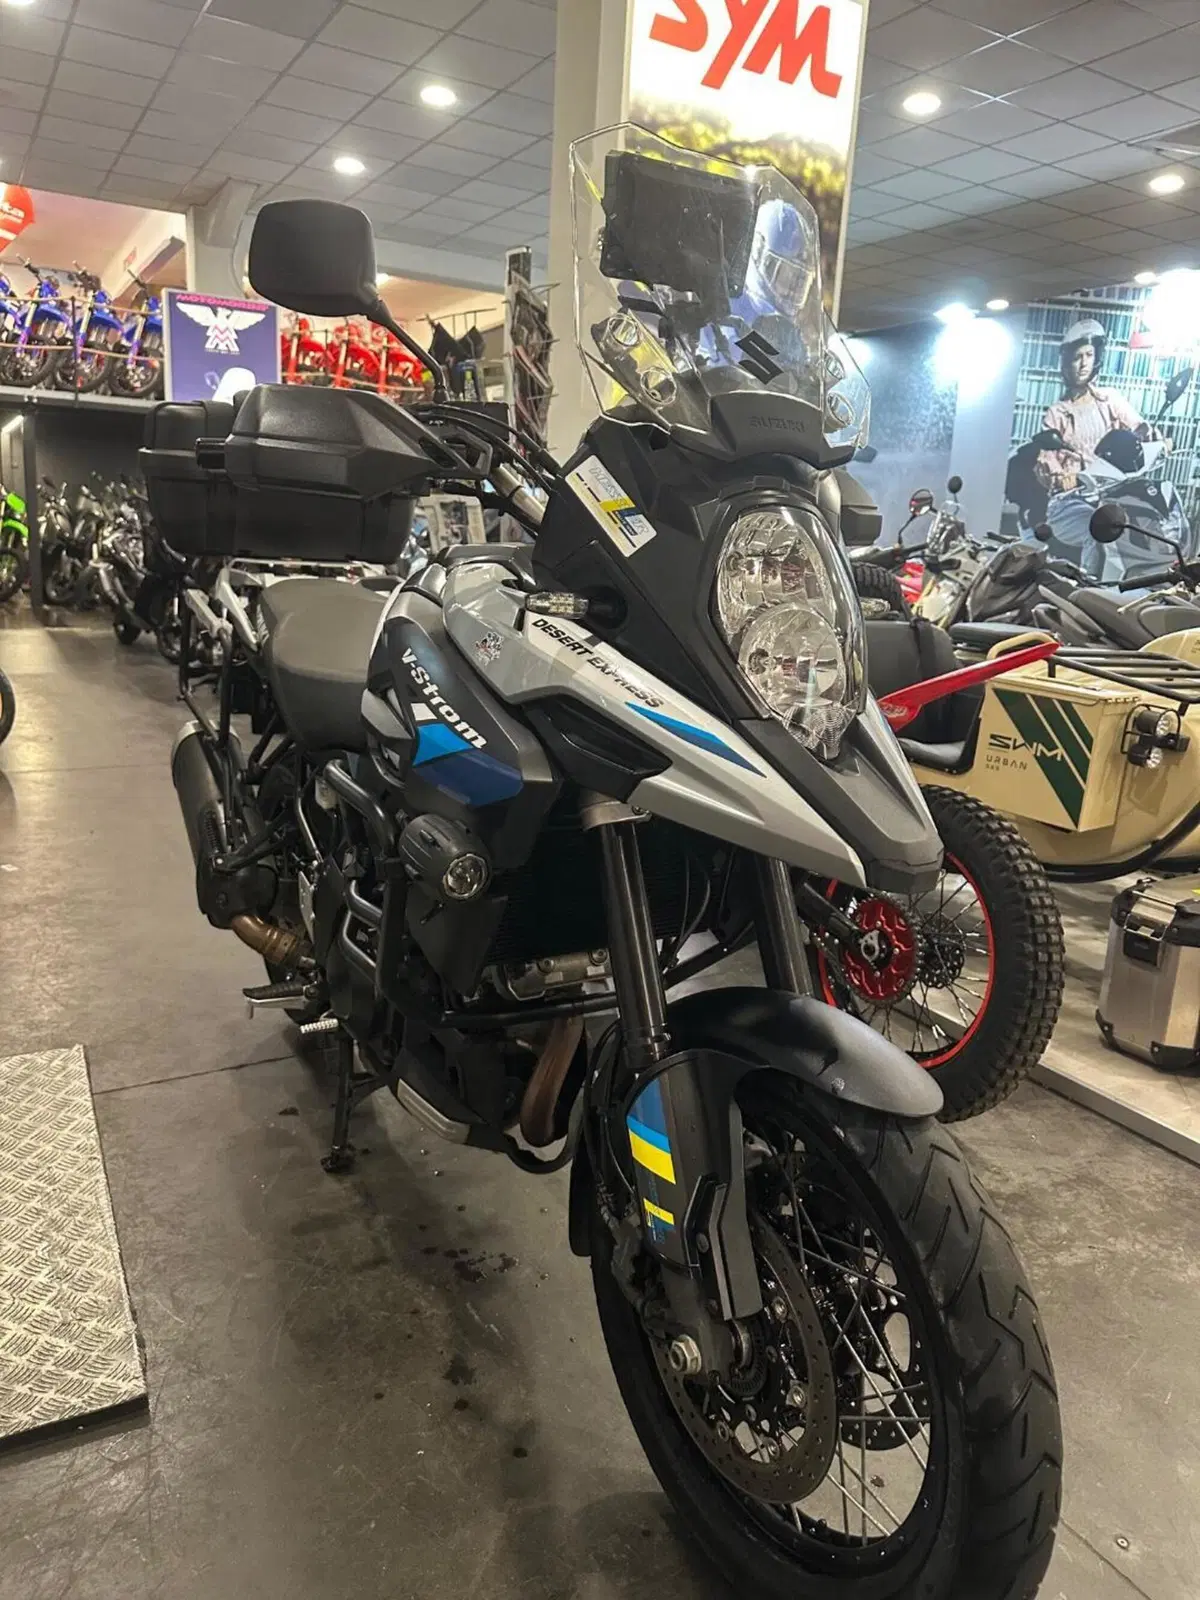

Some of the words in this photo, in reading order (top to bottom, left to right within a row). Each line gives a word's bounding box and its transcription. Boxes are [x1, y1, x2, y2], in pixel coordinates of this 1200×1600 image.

[748, 416, 805, 433] SUZUKI
[532, 618, 593, 656] DESERT
[401, 647, 487, 749] V-Strom
[988, 733, 1063, 762] SWM
[985, 754, 1028, 771] URBAN
